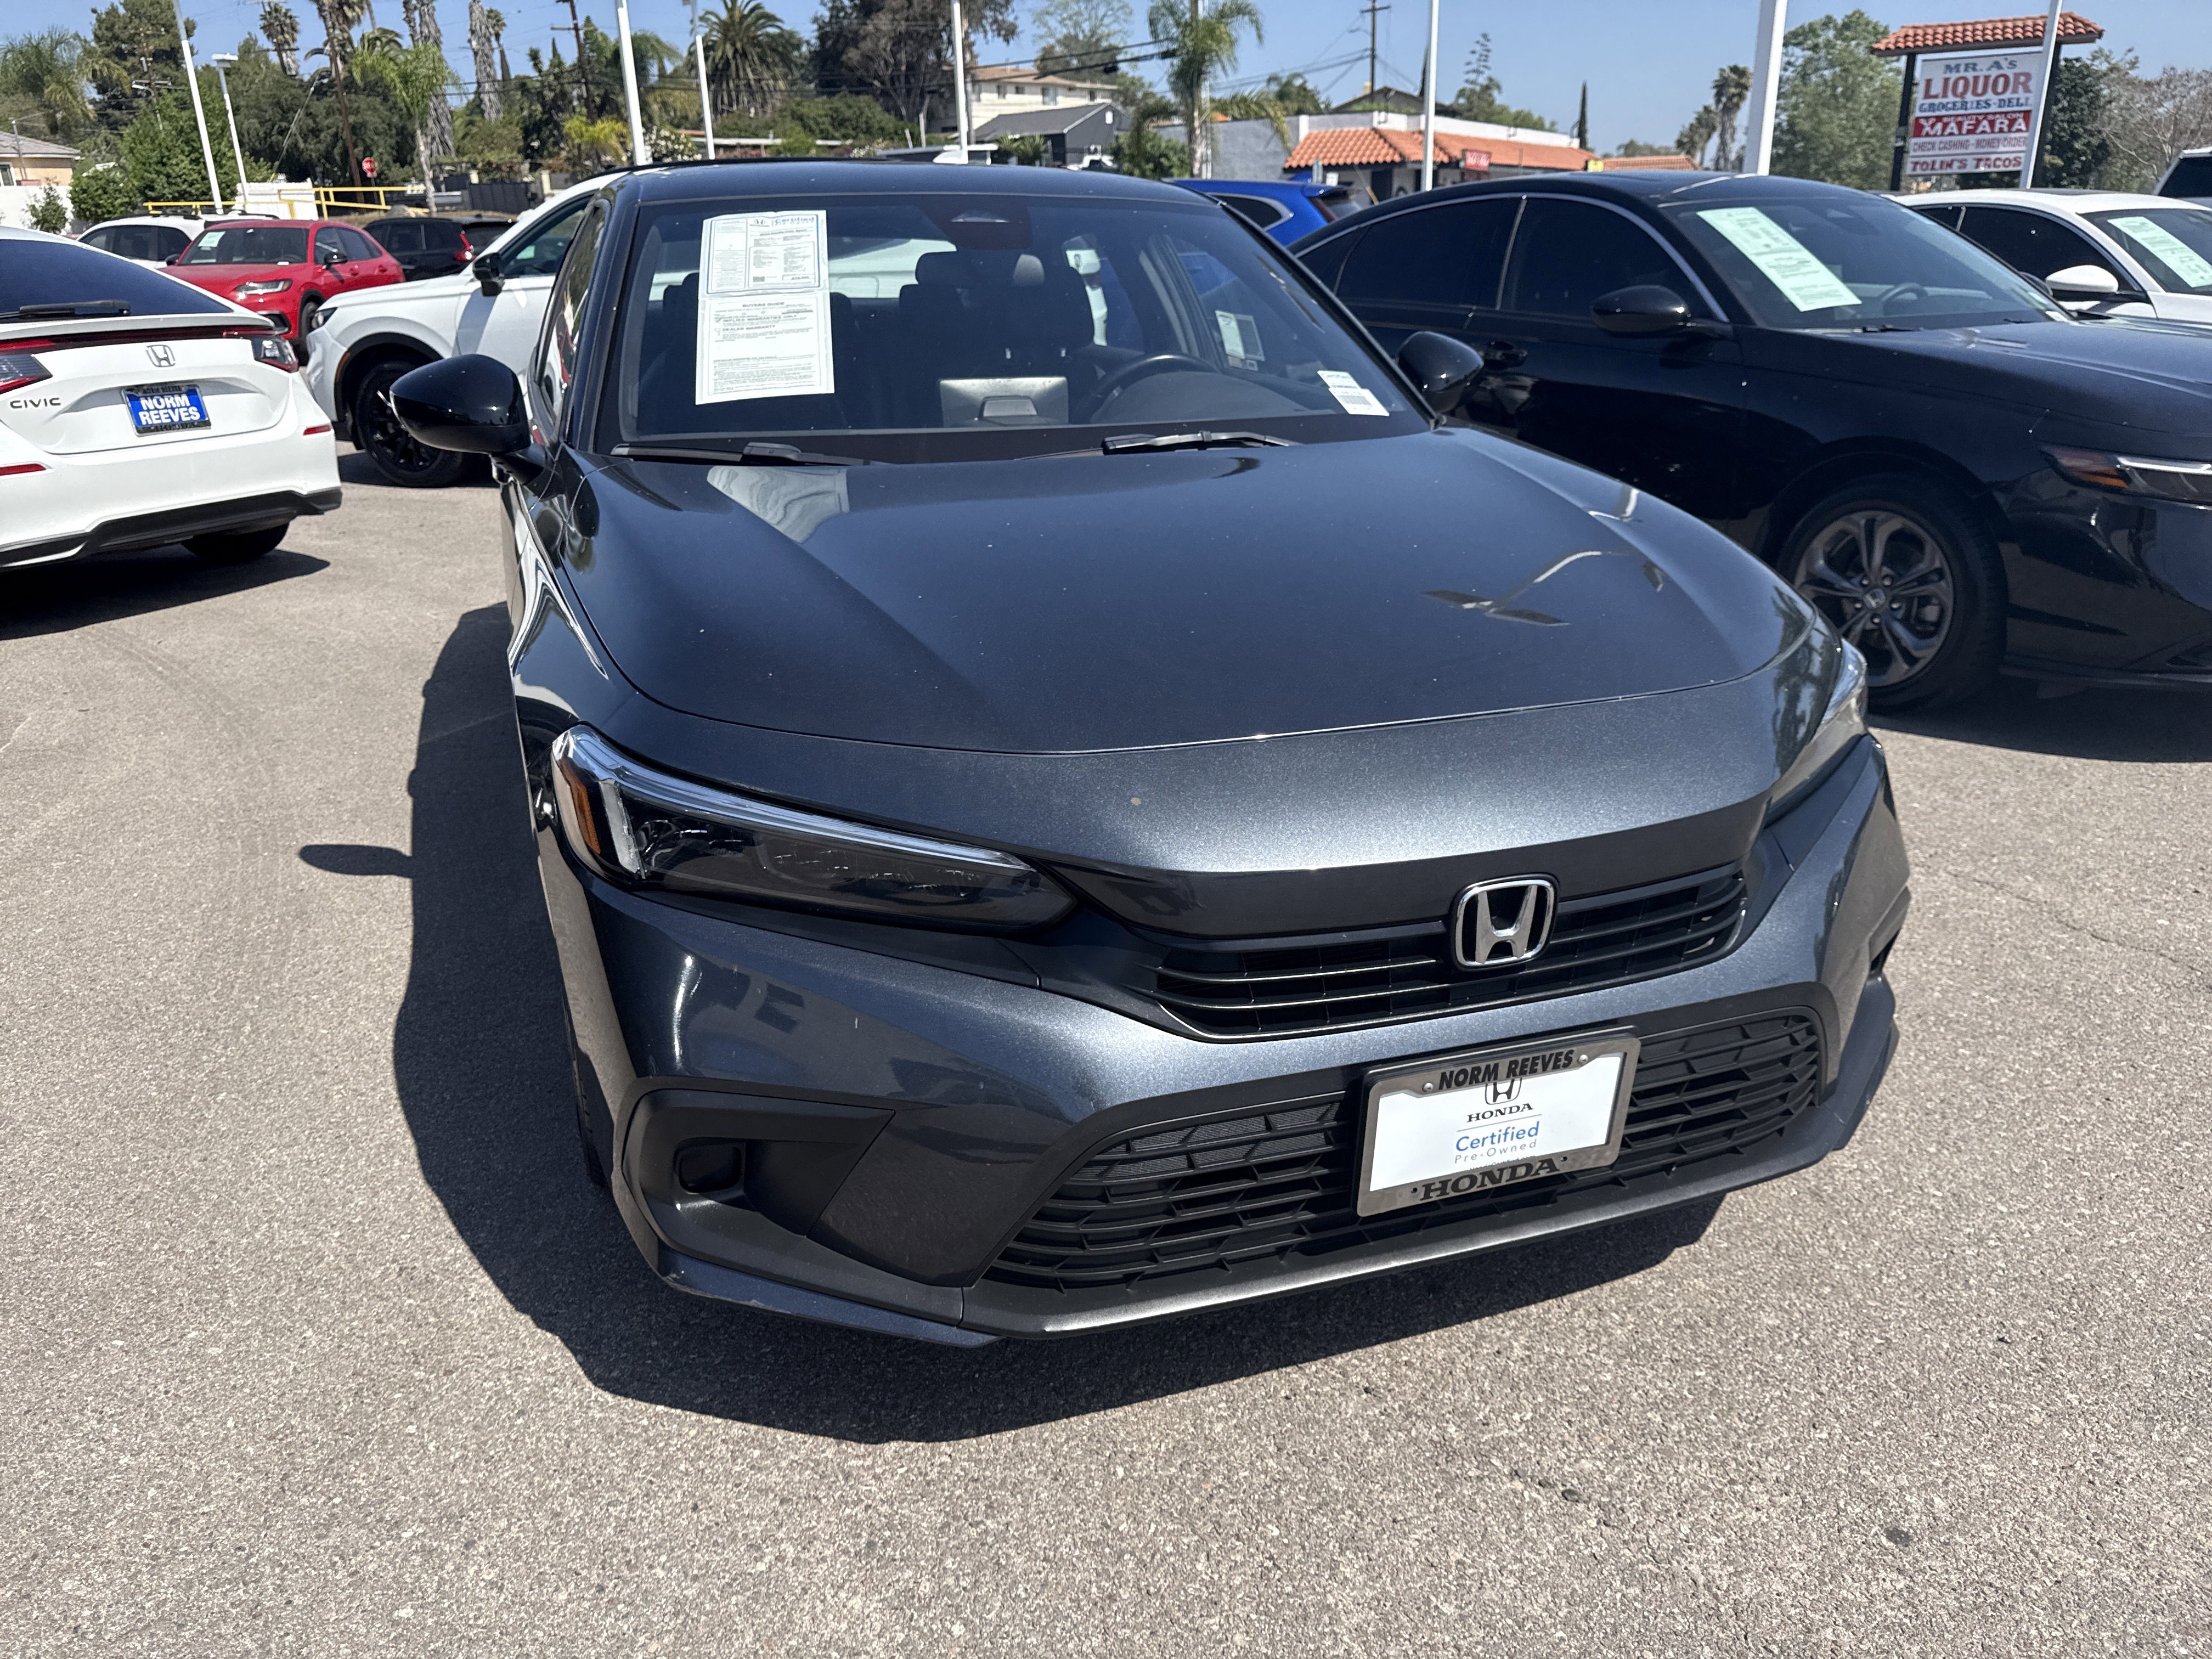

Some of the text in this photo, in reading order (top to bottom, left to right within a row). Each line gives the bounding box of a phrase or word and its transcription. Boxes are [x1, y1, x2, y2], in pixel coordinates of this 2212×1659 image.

[1922, 72, 2032, 99] LIQUOR
[1921, 118, 2027, 136] MAFARA
[1913, 140, 1936, 152] CHECK
[1975, 156, 2022, 170] TACOS
[10, 397, 61, 409] CIVIC
[139, 393, 190, 410] NORM
[138, 406, 201, 425] REEVES
[1438, 1049, 1576, 1091] NORM REEVES
[1466, 1103, 1533, 1123] HONDA
[1455, 1120, 1540, 1152] Certified
[1454, 1139, 1537, 1164] Pre-Owned
[1420, 1158, 1560, 1201] HONDA
